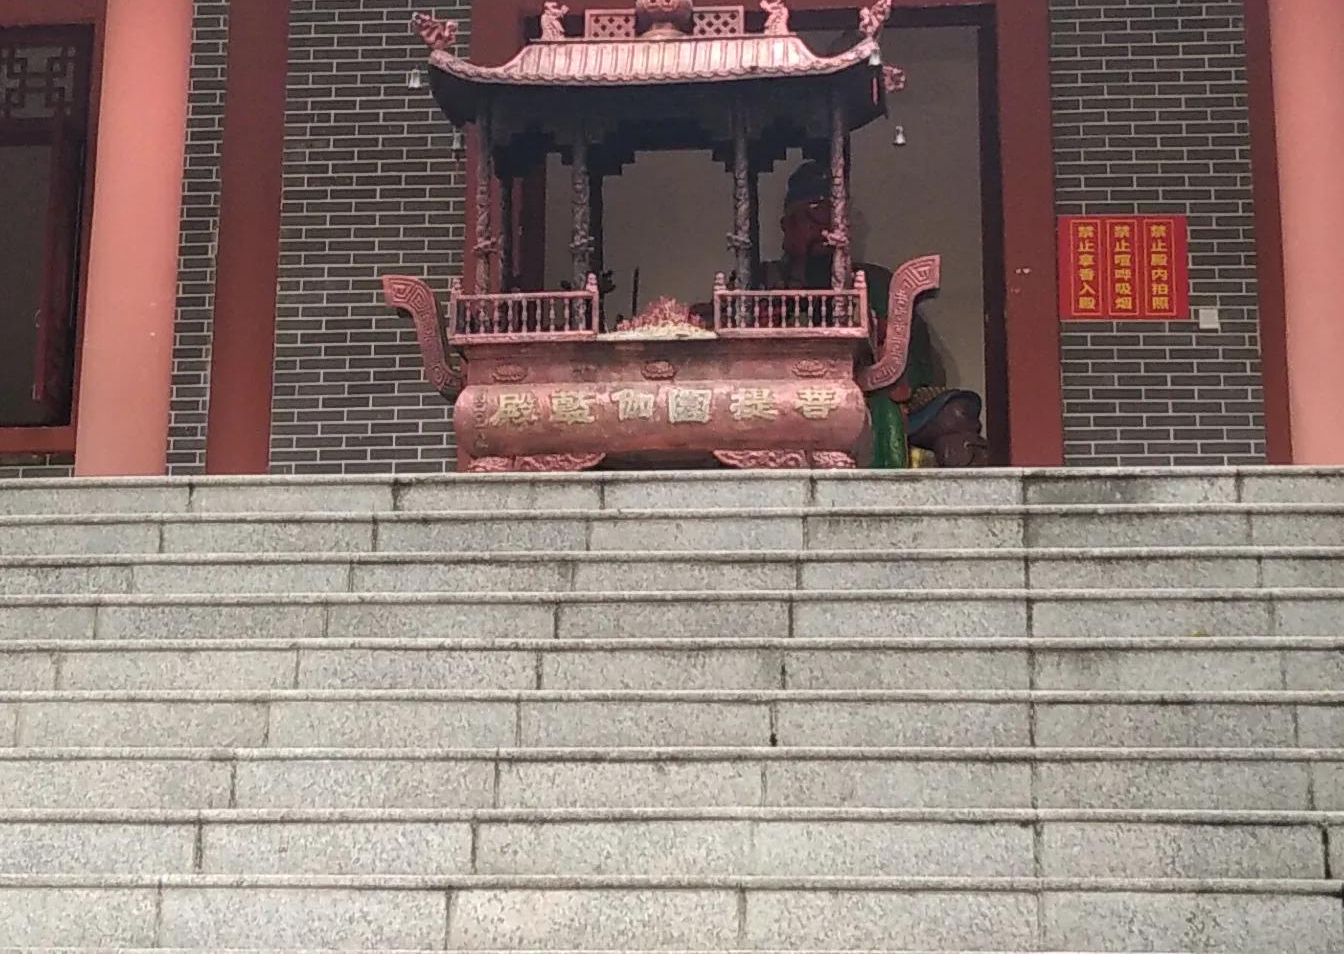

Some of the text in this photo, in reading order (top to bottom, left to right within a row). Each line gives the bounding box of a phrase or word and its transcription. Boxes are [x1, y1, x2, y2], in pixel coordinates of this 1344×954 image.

[1150, 225, 1169, 310] 禁止殿内拍照
